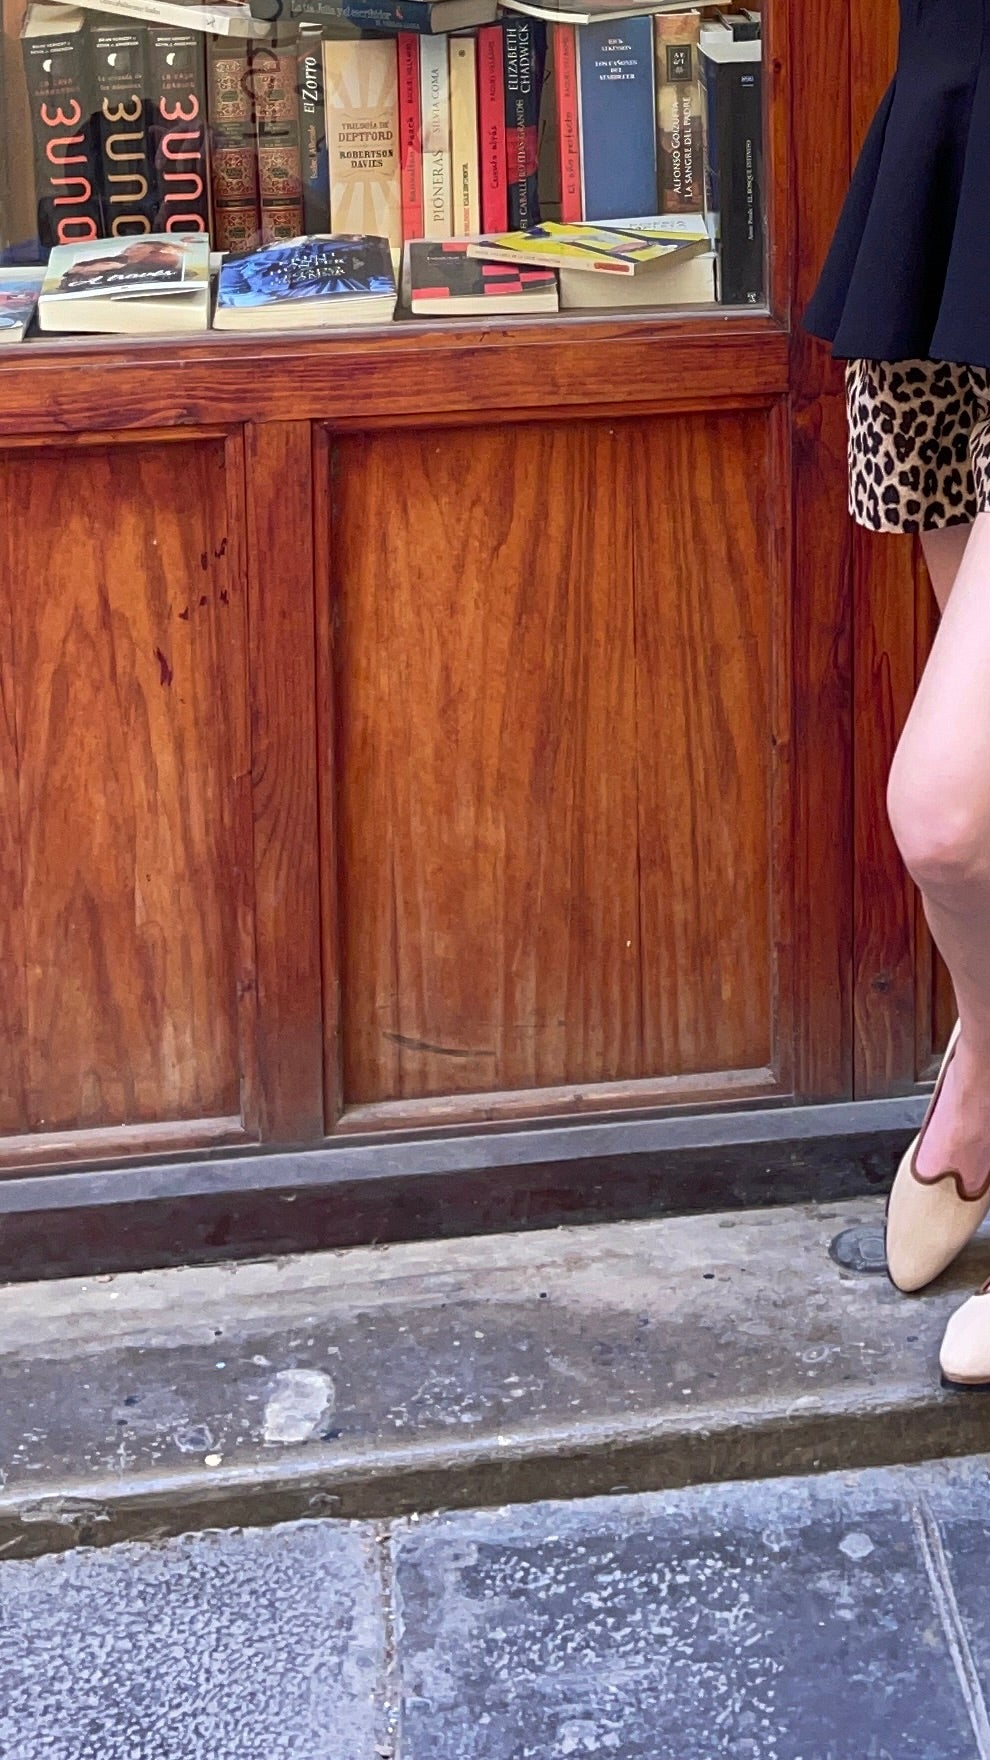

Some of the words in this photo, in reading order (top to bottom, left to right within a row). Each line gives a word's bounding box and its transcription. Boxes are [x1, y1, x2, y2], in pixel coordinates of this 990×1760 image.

[507, 28, 519, 91] ELIZABETH
[518, 23, 531, 94] CHADWICK
[301, 56, 319, 96] Zorro
[429, 67, 442, 100] COMA
[302, 96, 316, 114] El
[429, 101, 442, 135] SILVIA
[515, 99, 526, 140] GRANDE
[681, 96, 692, 127] PADRE
[338, 130, 393, 143] DEPTFORD
[564, 111, 577, 155] perfecto
[682, 127, 692, 146] DEL
[339, 149, 394, 161] ROBERTSON
[351, 158, 384, 170] DAVIES
[682, 147, 693, 185] SANGRE
[671, 150, 681, 195] ALFONSO
[683, 185, 693, 198] LA
